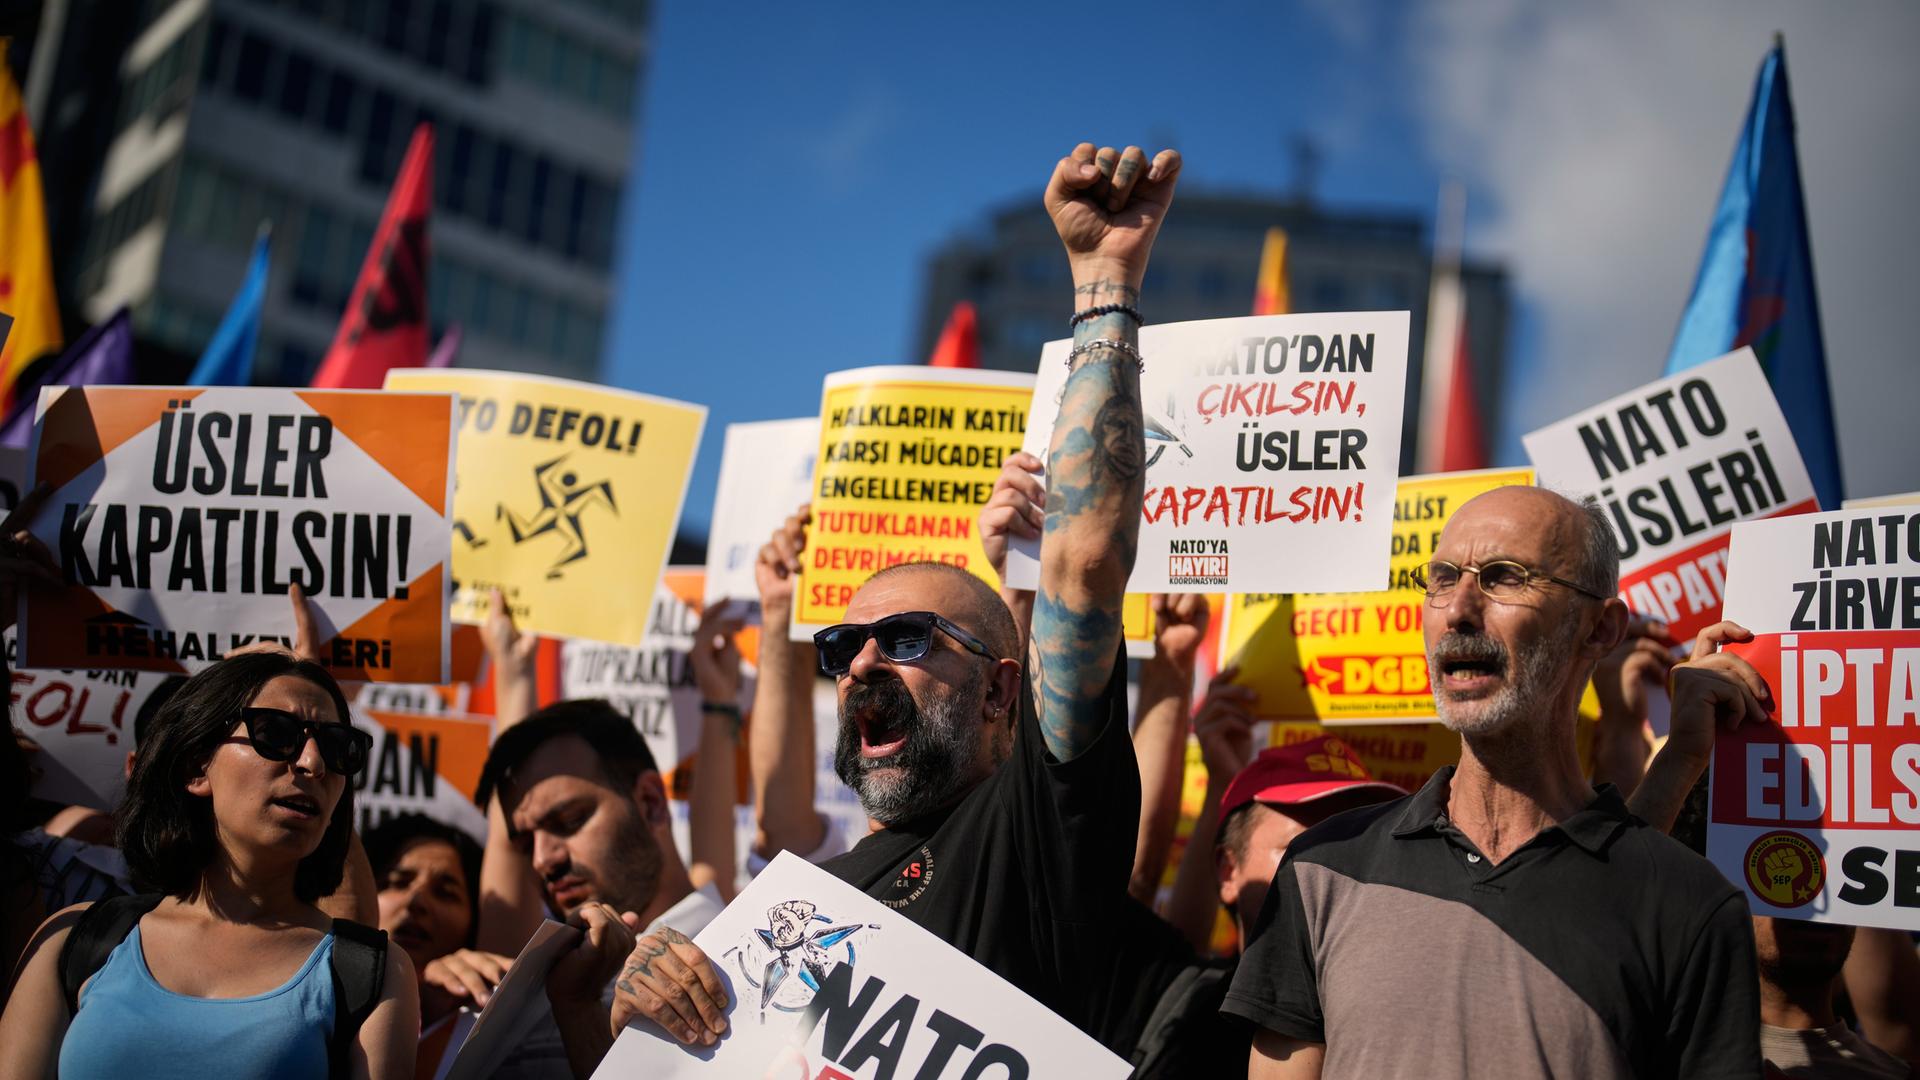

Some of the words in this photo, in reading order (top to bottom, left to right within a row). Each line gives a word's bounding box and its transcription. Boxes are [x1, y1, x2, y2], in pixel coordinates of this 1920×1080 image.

[830, 405, 954, 430] HALKLARIN
[964, 405, 1026, 433] KATİL
[1197, 380, 1366, 425] ÇIKILSIN,
[508, 403, 644, 457] DEFOL!
[1578, 376, 1727, 481] NATO
[152, 399, 334, 498] ÜSLER
[825, 439, 889, 466] KARŞI
[899, 437, 1022, 469] MÜCADEL
[1236, 422, 1368, 473] ÜSLER
[1141, 482, 1365, 529] KAPATILSIN!
[817, 510, 971, 539] TUTUKLANAN
[59, 502, 412, 600] KAPATILSIN!
[1170, 539, 1228, 554] NATO'YA
[1170, 557, 1227, 576] HAYIR!
[811, 583, 862, 607] SER
[1618, 547, 1729, 624] APAT
[1291, 601, 1365, 638] GEÇİT
[1343, 656, 1429, 694] DGB
[910, 886, 926, 901] THE
[1773, 875, 1791, 885] SEP
